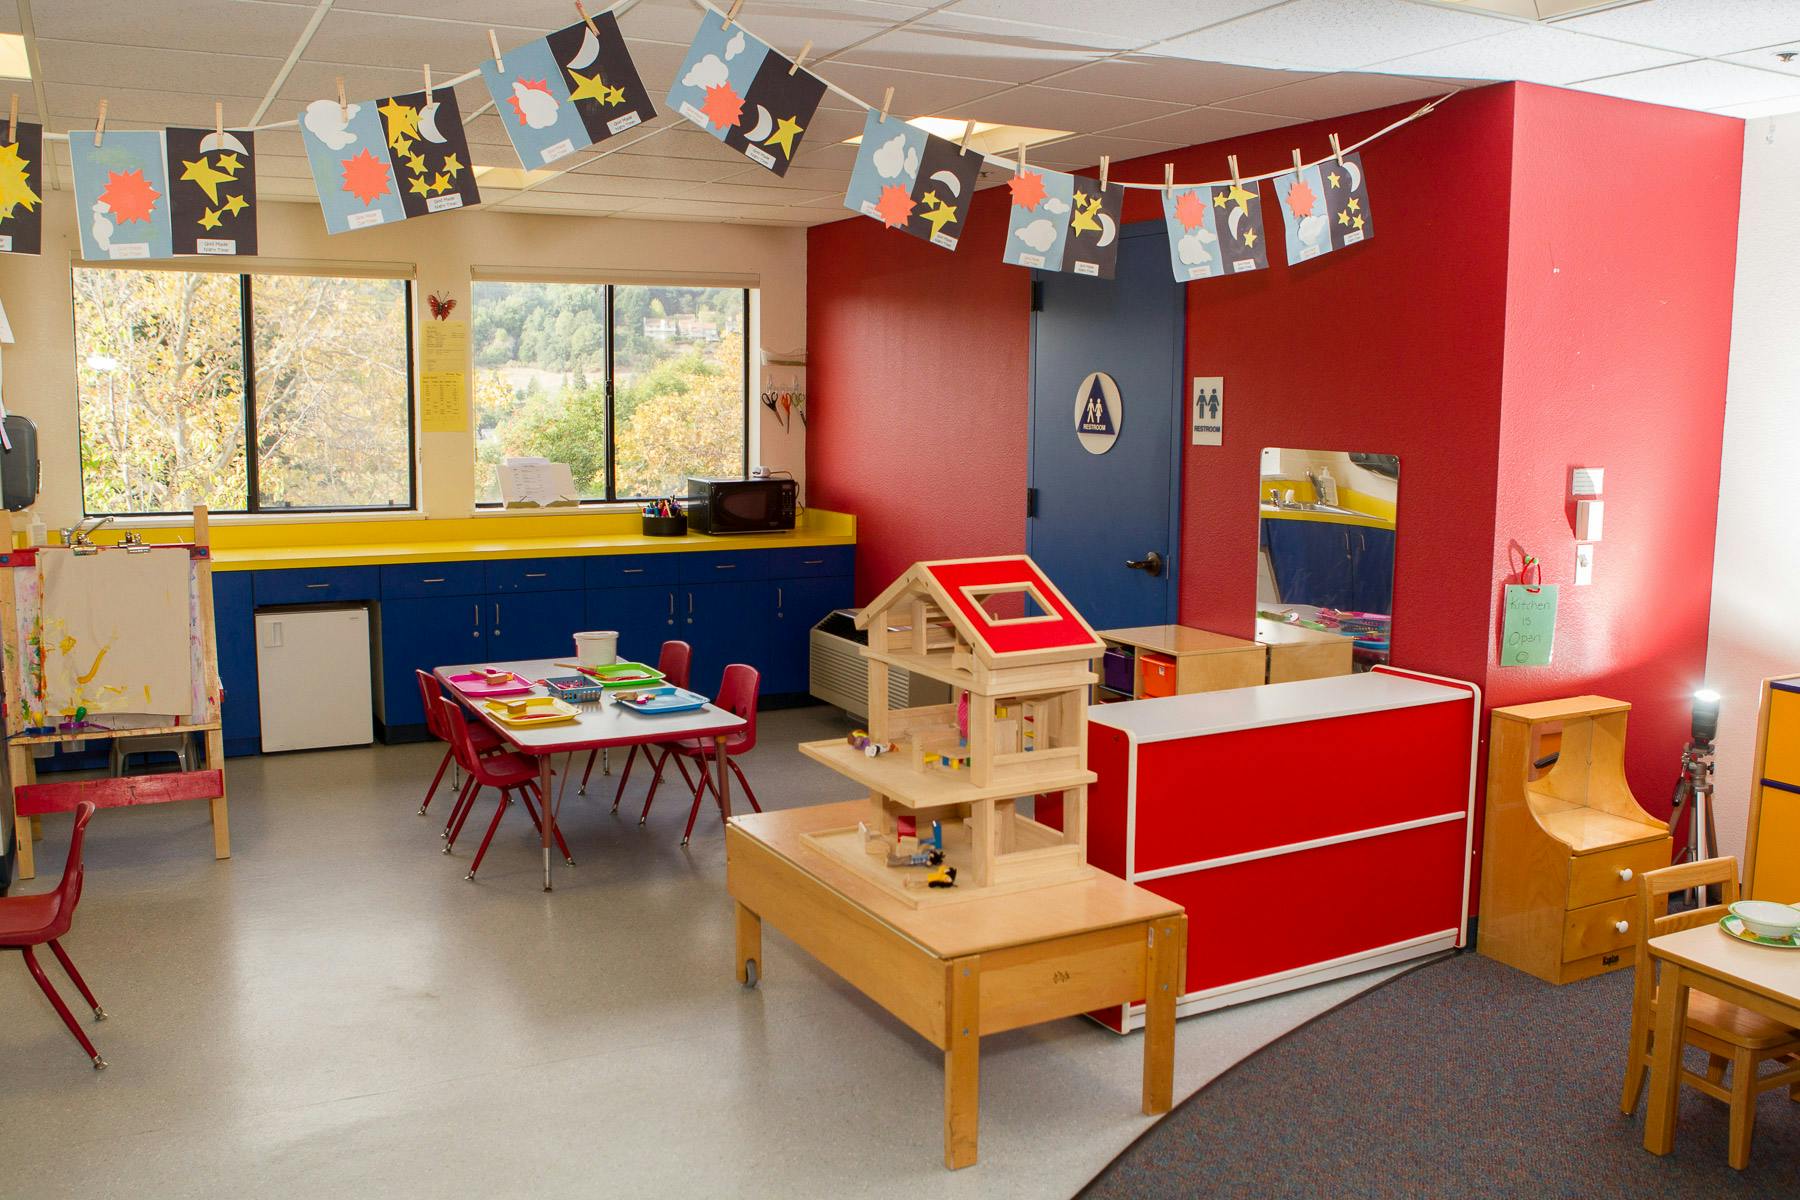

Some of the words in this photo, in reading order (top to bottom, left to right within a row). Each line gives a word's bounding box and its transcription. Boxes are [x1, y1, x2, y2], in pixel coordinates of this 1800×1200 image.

[1083, 423, 1106, 431] RESTROOM
[1193, 425, 1221, 433] RESTROOM
[1511, 597, 1550, 610] Kitchen
[1509, 631, 1542, 646] Open
